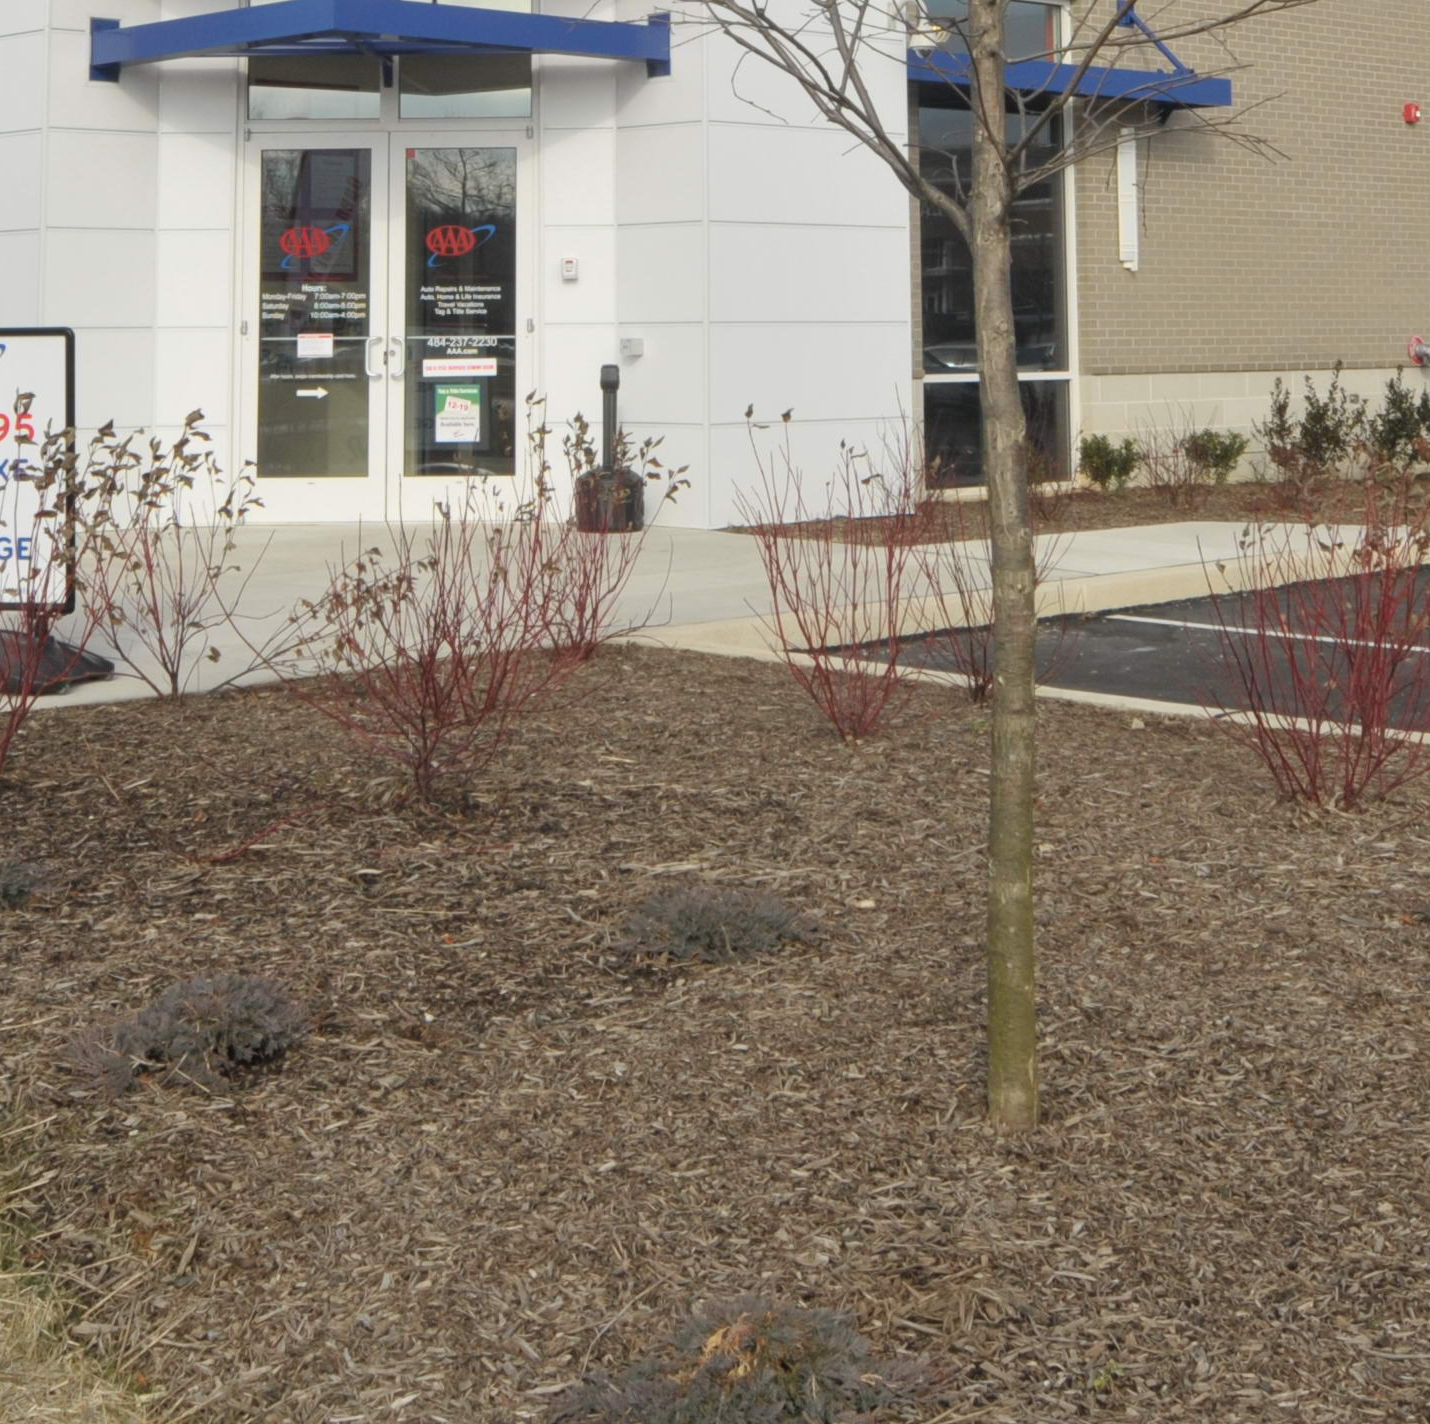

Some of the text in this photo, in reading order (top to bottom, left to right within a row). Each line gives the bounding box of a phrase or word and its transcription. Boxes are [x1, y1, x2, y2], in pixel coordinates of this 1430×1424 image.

[278, 225, 331, 258] AAA
[426, 224, 476, 257] AAA
[301, 283, 327, 292] Hours:
[262, 302, 289, 310] Saturday
[262, 311, 285, 320] Sunday
[427, 336, 498, 347] 484-237-2230
[446, 347, 478, 355] AAA.com
